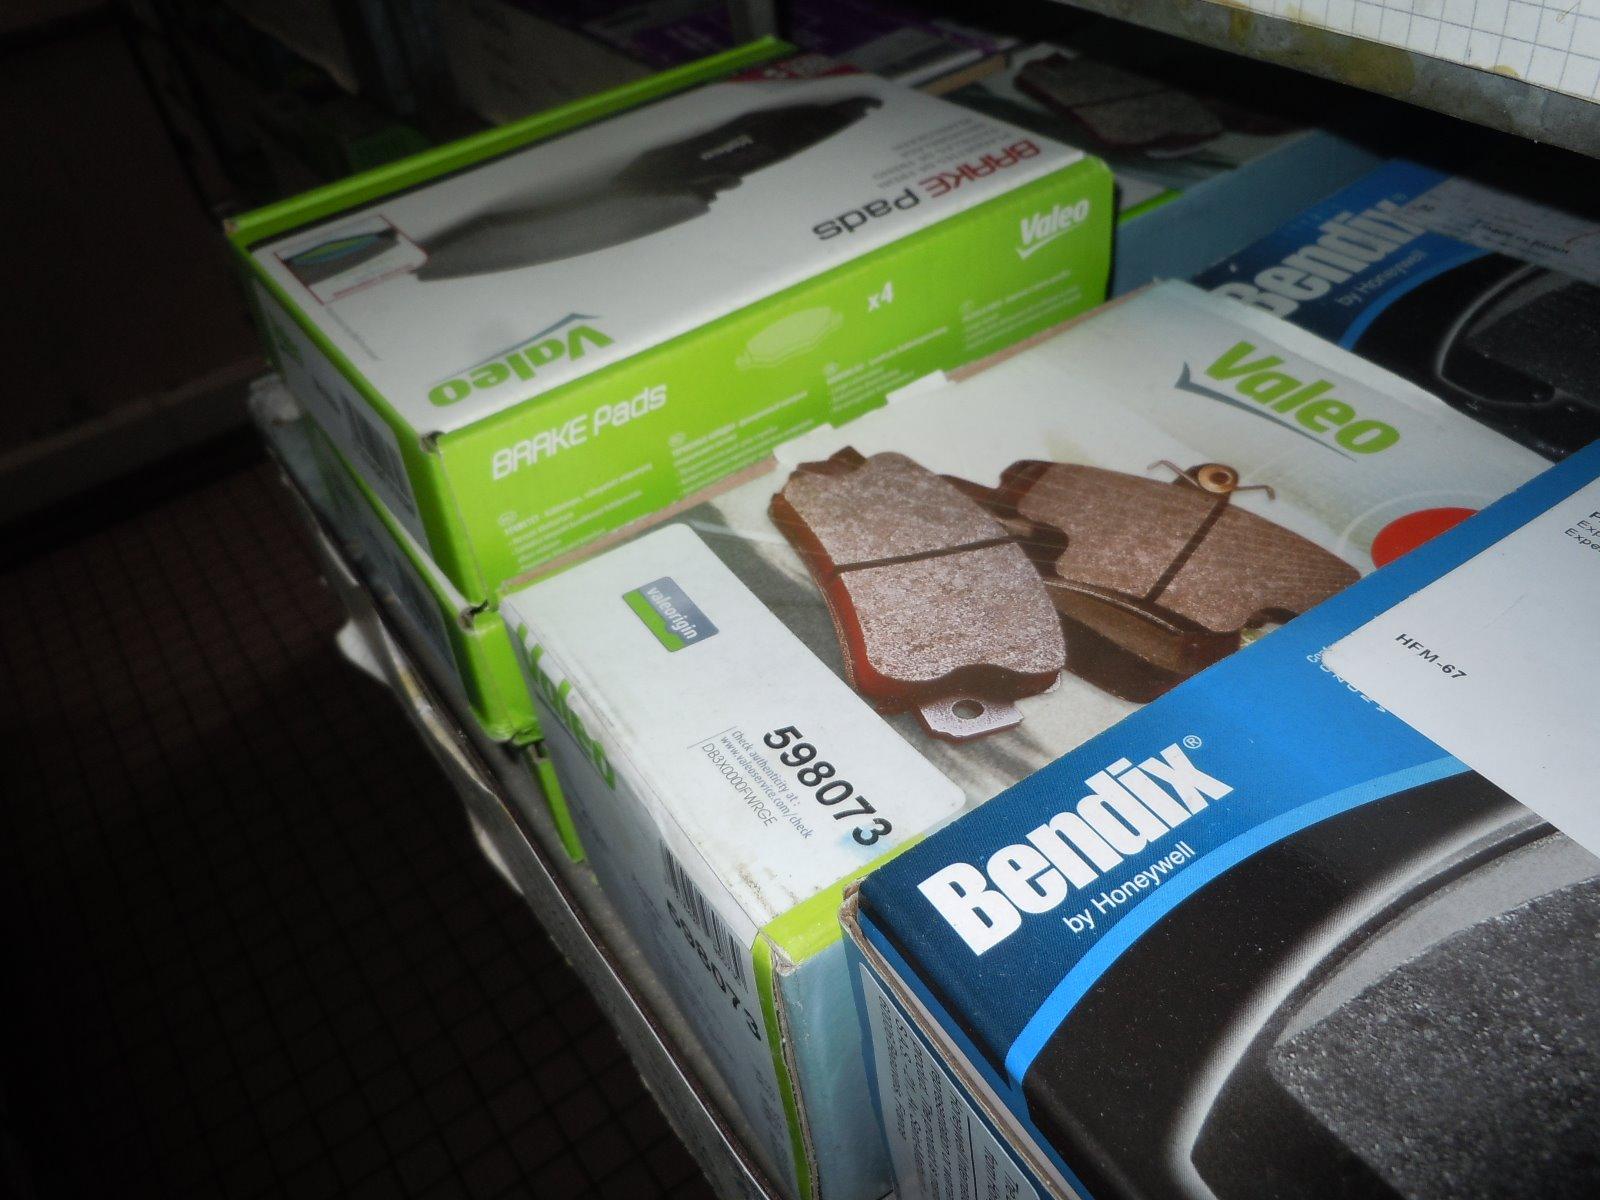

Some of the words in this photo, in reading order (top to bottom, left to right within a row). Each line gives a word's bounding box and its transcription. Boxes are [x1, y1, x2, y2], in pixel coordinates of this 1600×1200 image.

[922, 140, 1041, 199] BRAKE
[813, 187, 919, 242] Pads
[1019, 200, 1090, 246] Valeo
[866, 282, 894, 314] x4
[428, 325, 614, 408] Valeo
[1205, 342, 1400, 455] Valeo
[492, 417, 588, 480] BRAKE
[592, 384, 668, 436] Pads
[646, 587, 698, 640] valeorigin
[1394, 633, 1467, 681] HFM-67
[720, 735, 814, 839] www.valeoservice.com/check
[732, 730, 753, 753] Check
[749, 748, 791, 795] authenticity
[763, 726, 892, 846] 598073
[917, 744, 1234, 957] Bendix
[1063, 904, 1096, 935] by
[1095, 842, 1196, 916] Honeywell
